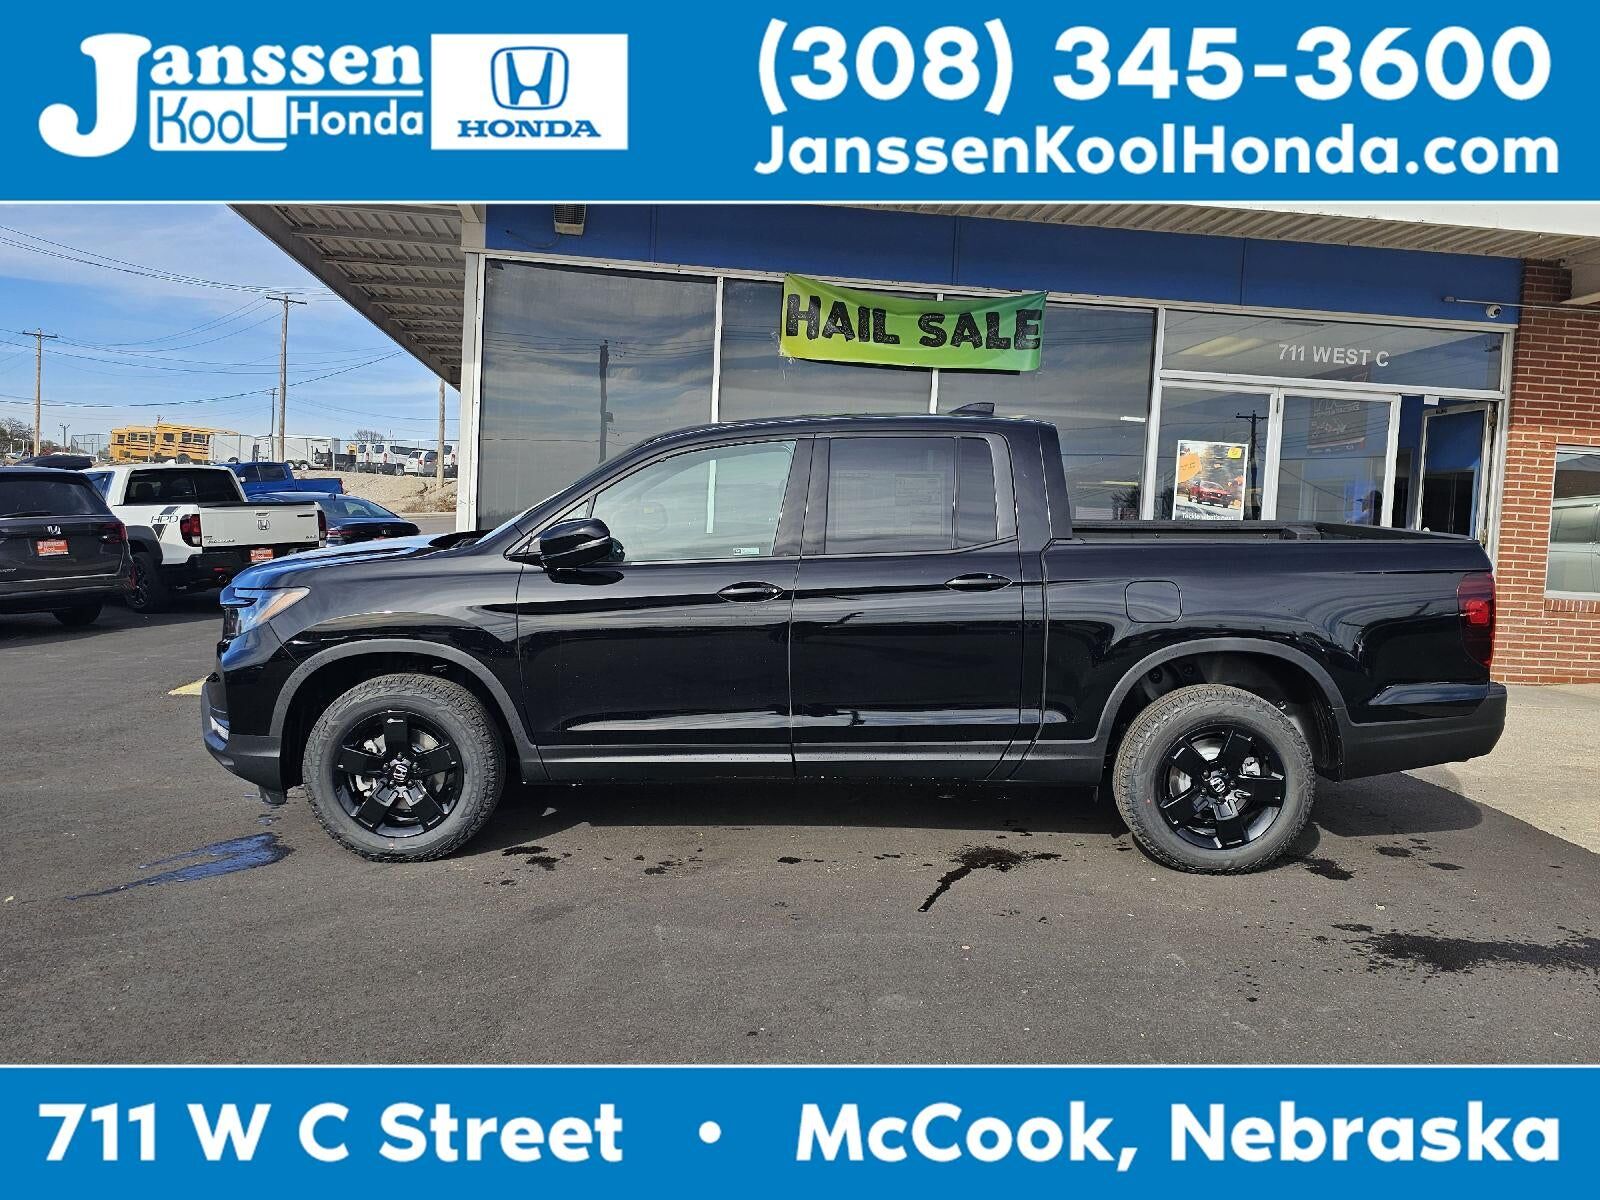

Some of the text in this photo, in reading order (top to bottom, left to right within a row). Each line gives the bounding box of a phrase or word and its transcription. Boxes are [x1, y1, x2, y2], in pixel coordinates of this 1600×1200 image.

[786, 293, 1043, 350] HAIL SALE
[1279, 343, 1390, 367] 711 WEST C
[150, 515, 179, 524] HPD
